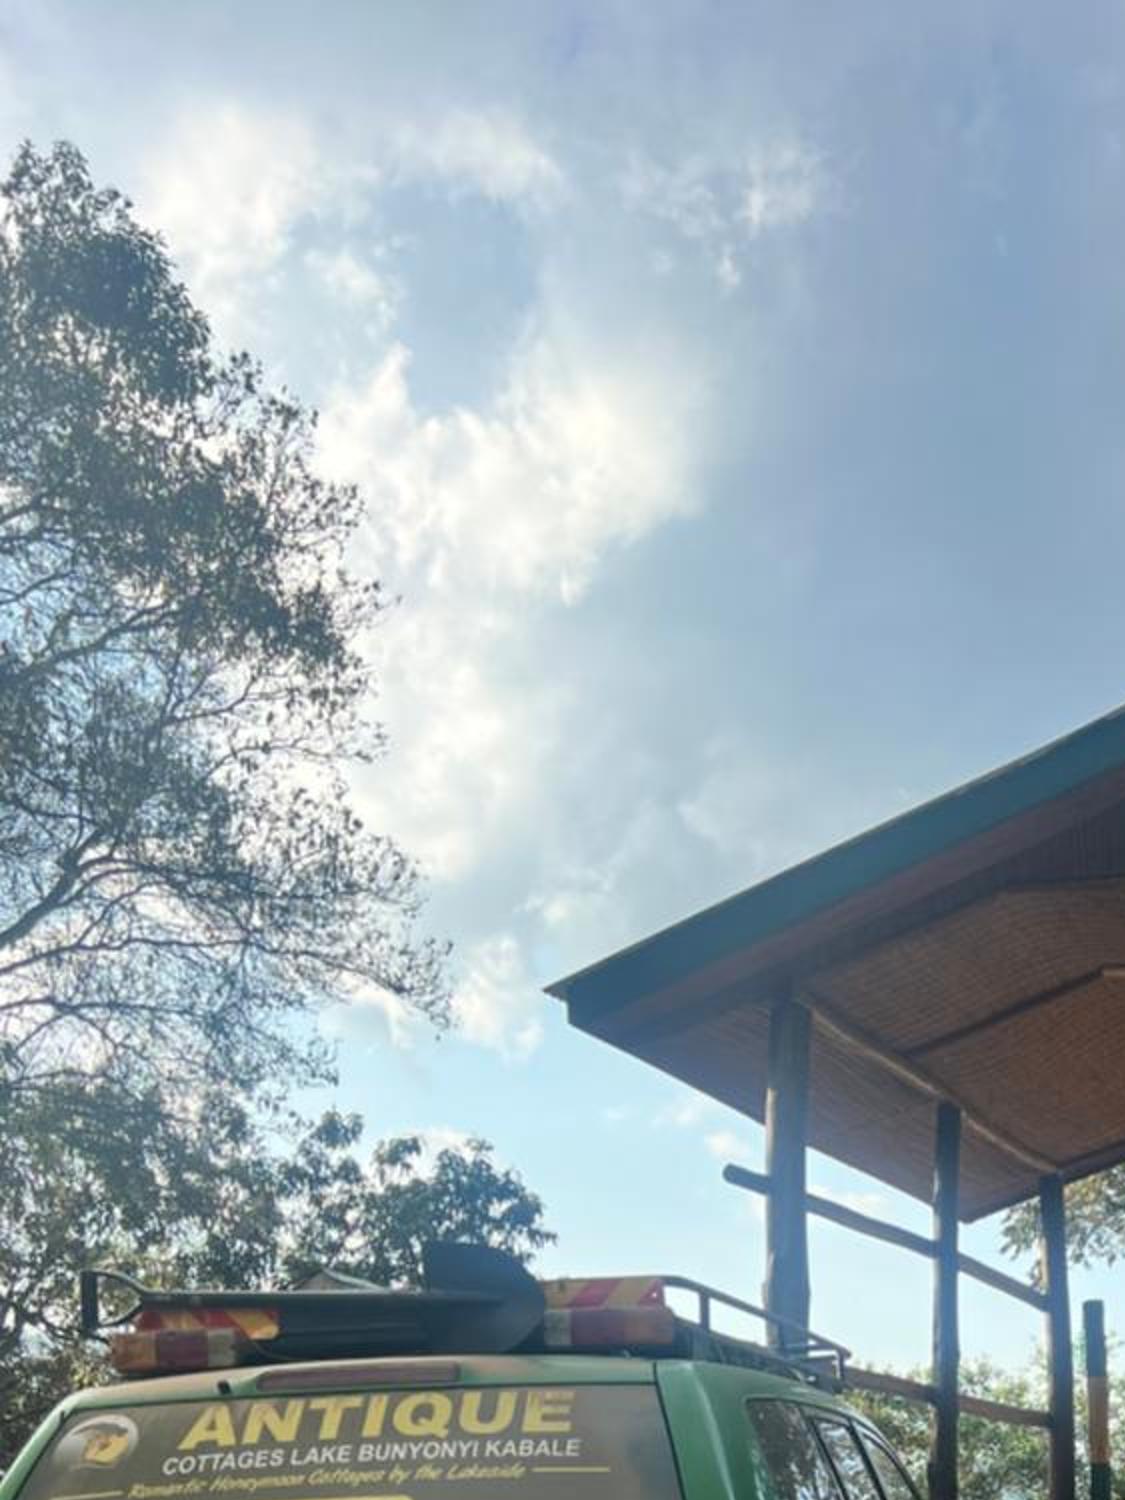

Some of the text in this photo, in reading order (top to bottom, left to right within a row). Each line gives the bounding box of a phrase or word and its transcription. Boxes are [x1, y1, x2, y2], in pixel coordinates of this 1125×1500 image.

[177, 1390, 575, 1450] ANTIQUE
[163, 1439, 582, 1475] COTTAGES LAKE BUNYONYI KABALE
